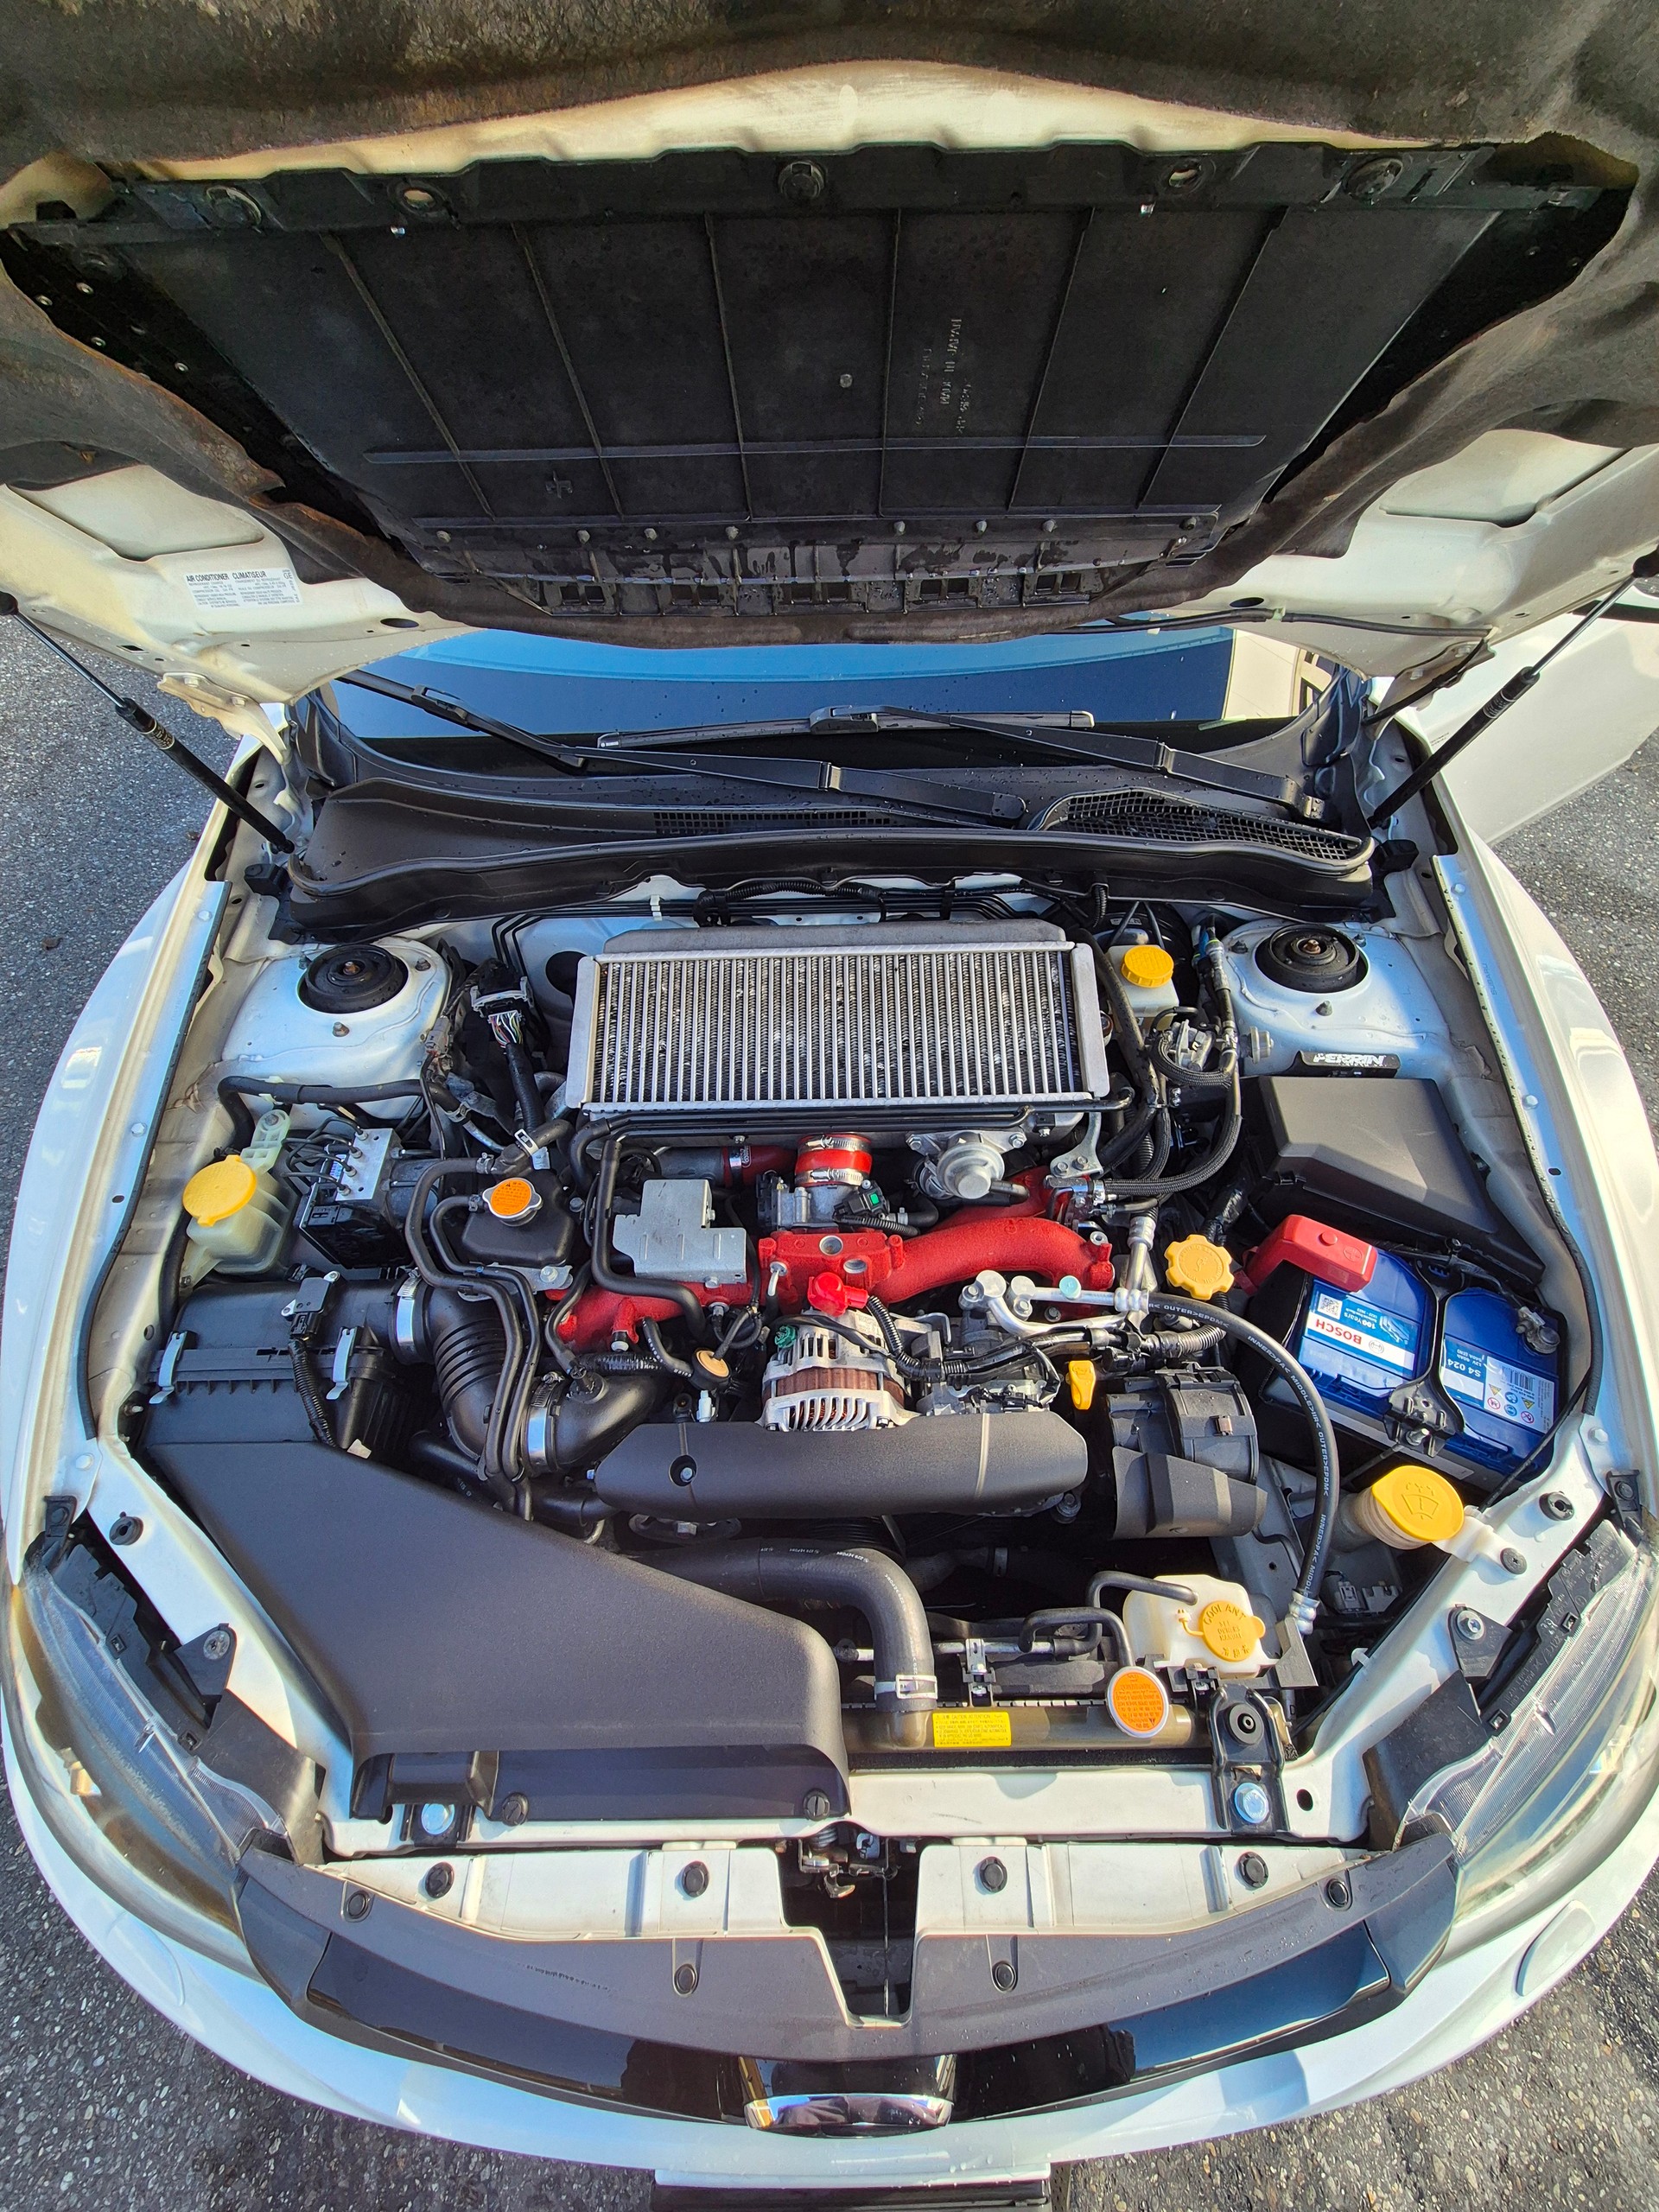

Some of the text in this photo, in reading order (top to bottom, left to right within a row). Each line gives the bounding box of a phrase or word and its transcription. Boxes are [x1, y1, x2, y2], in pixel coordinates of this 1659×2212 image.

[196, 573, 229, 582] CONDITIONER
[232, 571, 267, 580] CLIMATISEUR
[1313, 1052, 1384, 1065] PERRIN
[1316, 1319, 1362, 1344] BOSCH
[1447, 1358, 1482, 1377] S4 024
